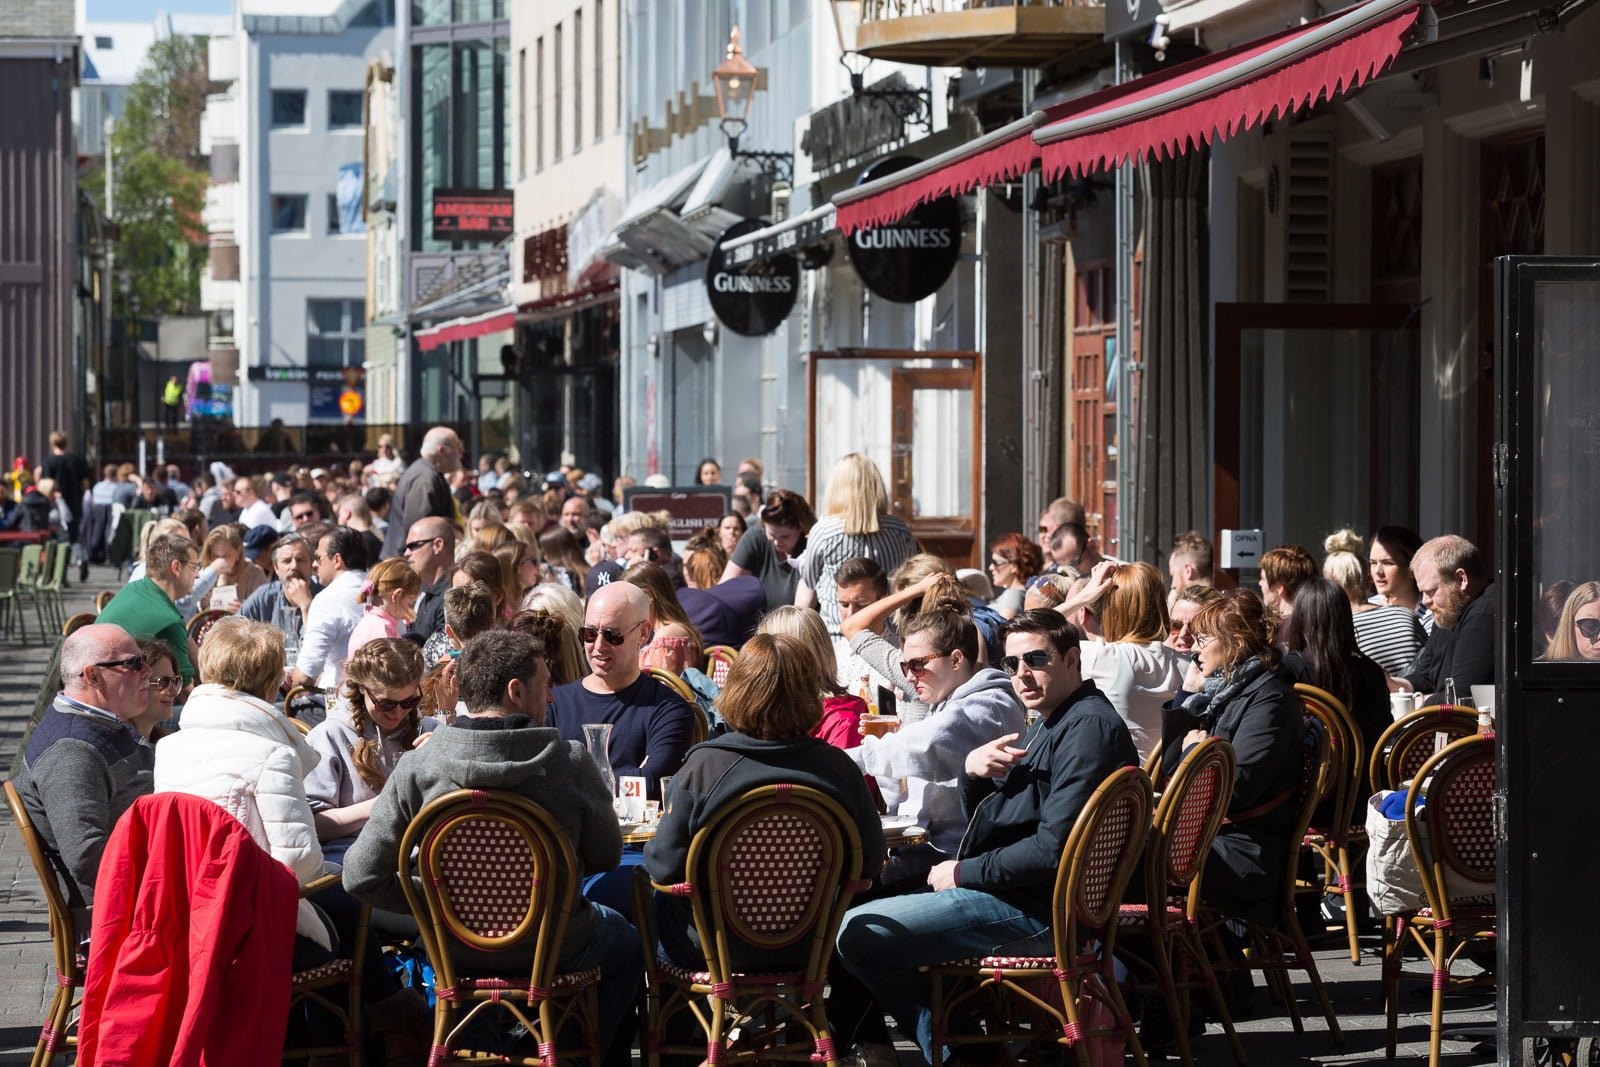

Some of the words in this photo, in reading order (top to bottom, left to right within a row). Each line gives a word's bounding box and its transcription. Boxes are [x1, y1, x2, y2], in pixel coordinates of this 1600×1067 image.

[434, 203, 513, 217] AMERICAN
[458, 217, 490, 231] BAR
[854, 226, 952, 250] GUINNESS
[713, 271, 793, 293] GUINNESS
[624, 781, 640, 797] 21
